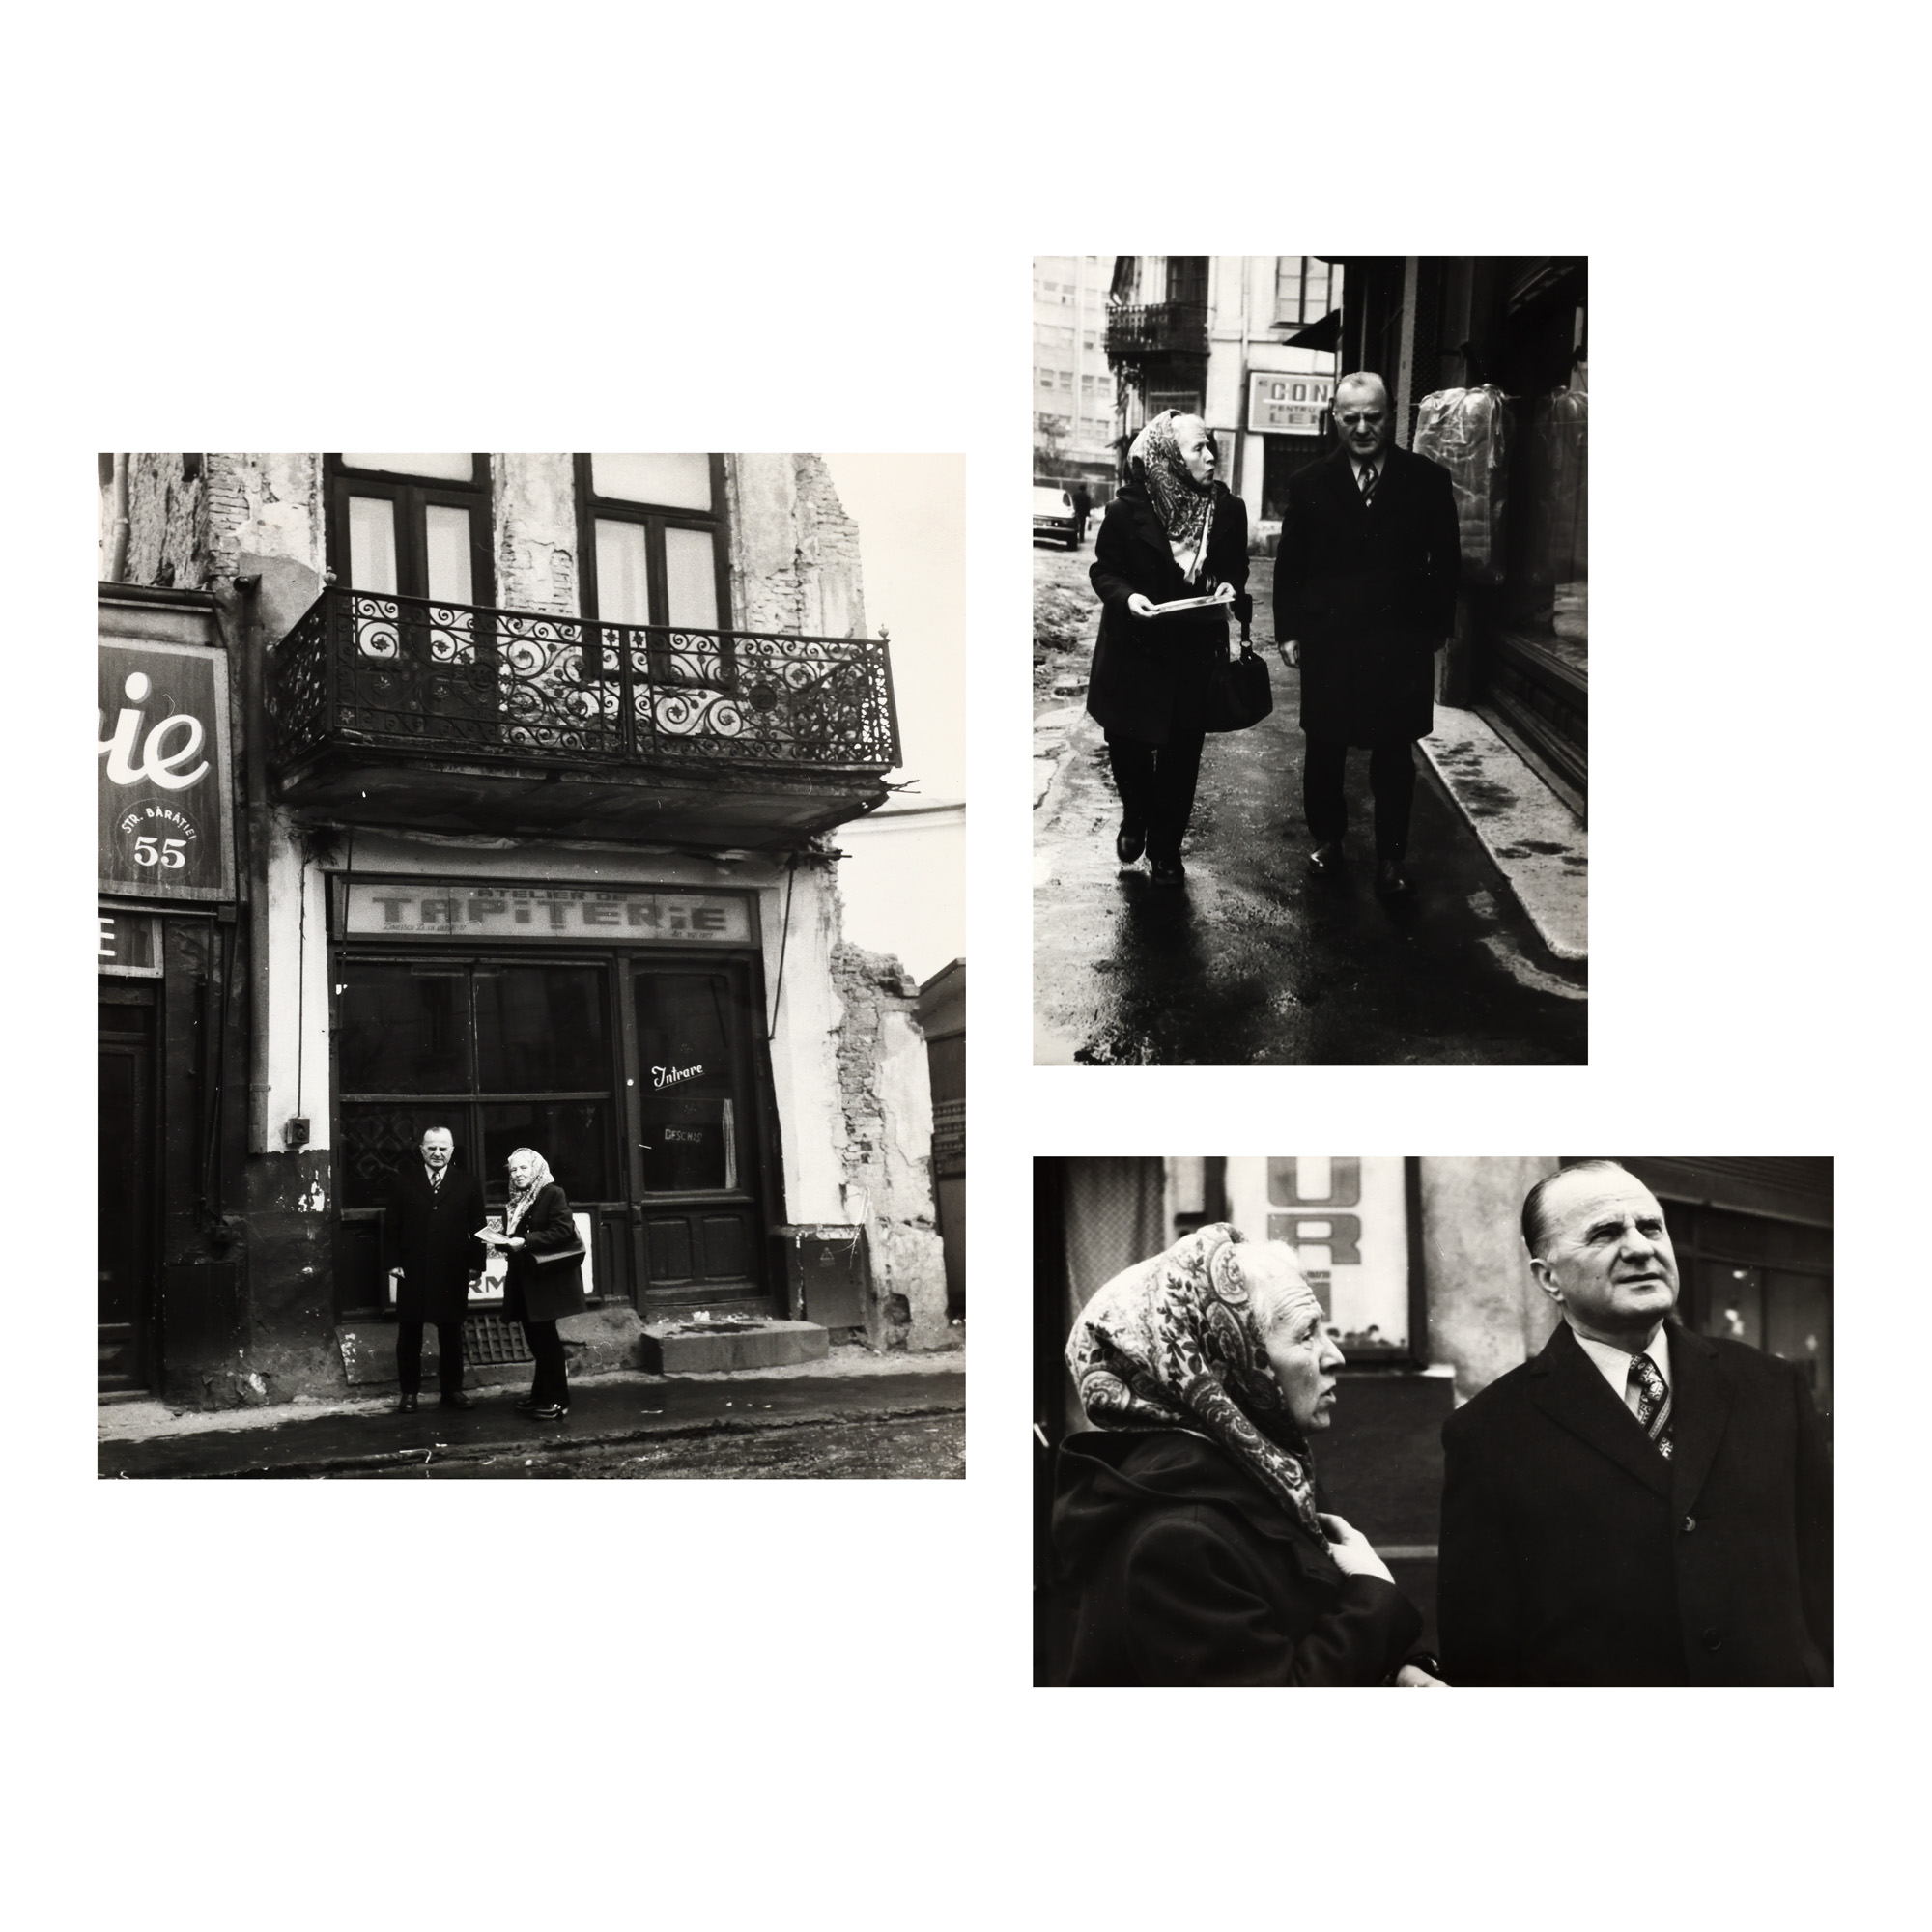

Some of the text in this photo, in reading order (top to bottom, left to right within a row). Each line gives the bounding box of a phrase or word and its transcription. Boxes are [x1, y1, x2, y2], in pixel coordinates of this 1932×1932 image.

[98, 672, 210, 790] ie
[121, 814, 144, 834] STR.
[133, 836, 187, 868] 55
[477, 888, 628, 901] ATELIER DE
[651, 1065, 704, 1088] Intrare
[664, 1128, 703, 1142] DESCHIS
